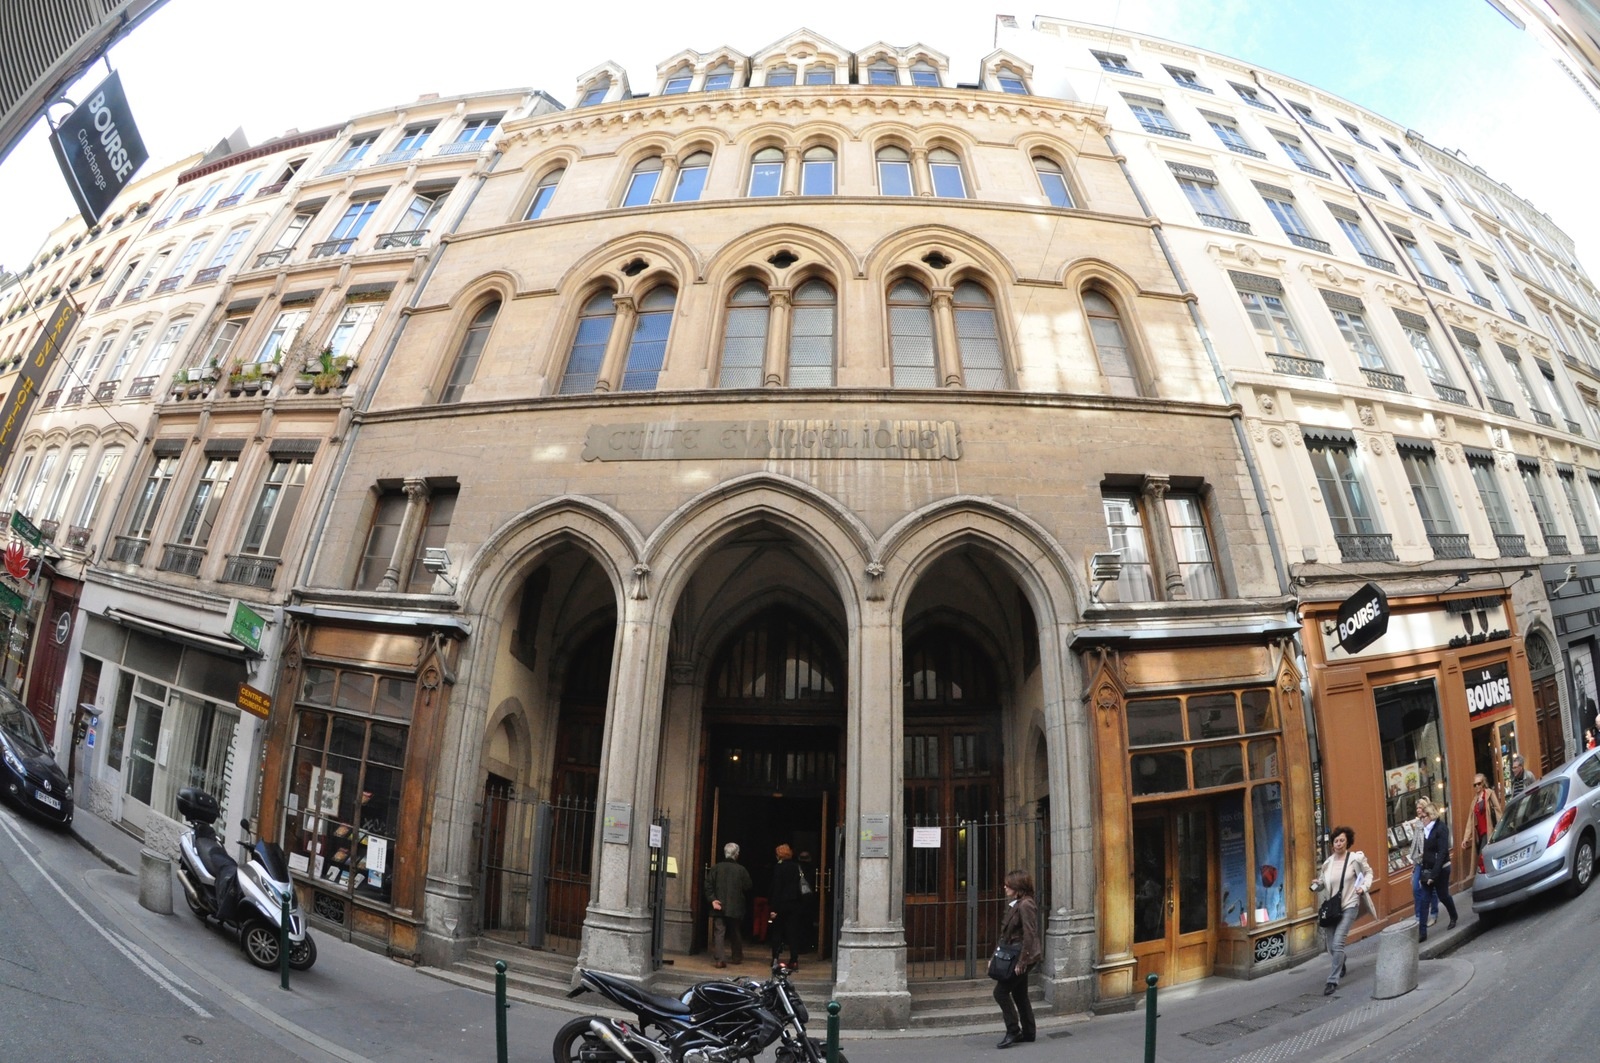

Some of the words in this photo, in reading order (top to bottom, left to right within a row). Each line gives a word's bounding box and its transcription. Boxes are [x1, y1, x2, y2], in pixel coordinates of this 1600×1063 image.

[88, 91, 133, 183] BOURSE
[78, 128, 107, 190] Cinéchange
[34, 306, 72, 368] GRAND
[608, 428, 701, 451] CULTE
[1339, 597, 1381, 641] BOURSE
[241, 687, 262, 703] CENTRE
[1466, 677, 1512, 713] BOURSE
[1482, 670, 1491, 680] LA
